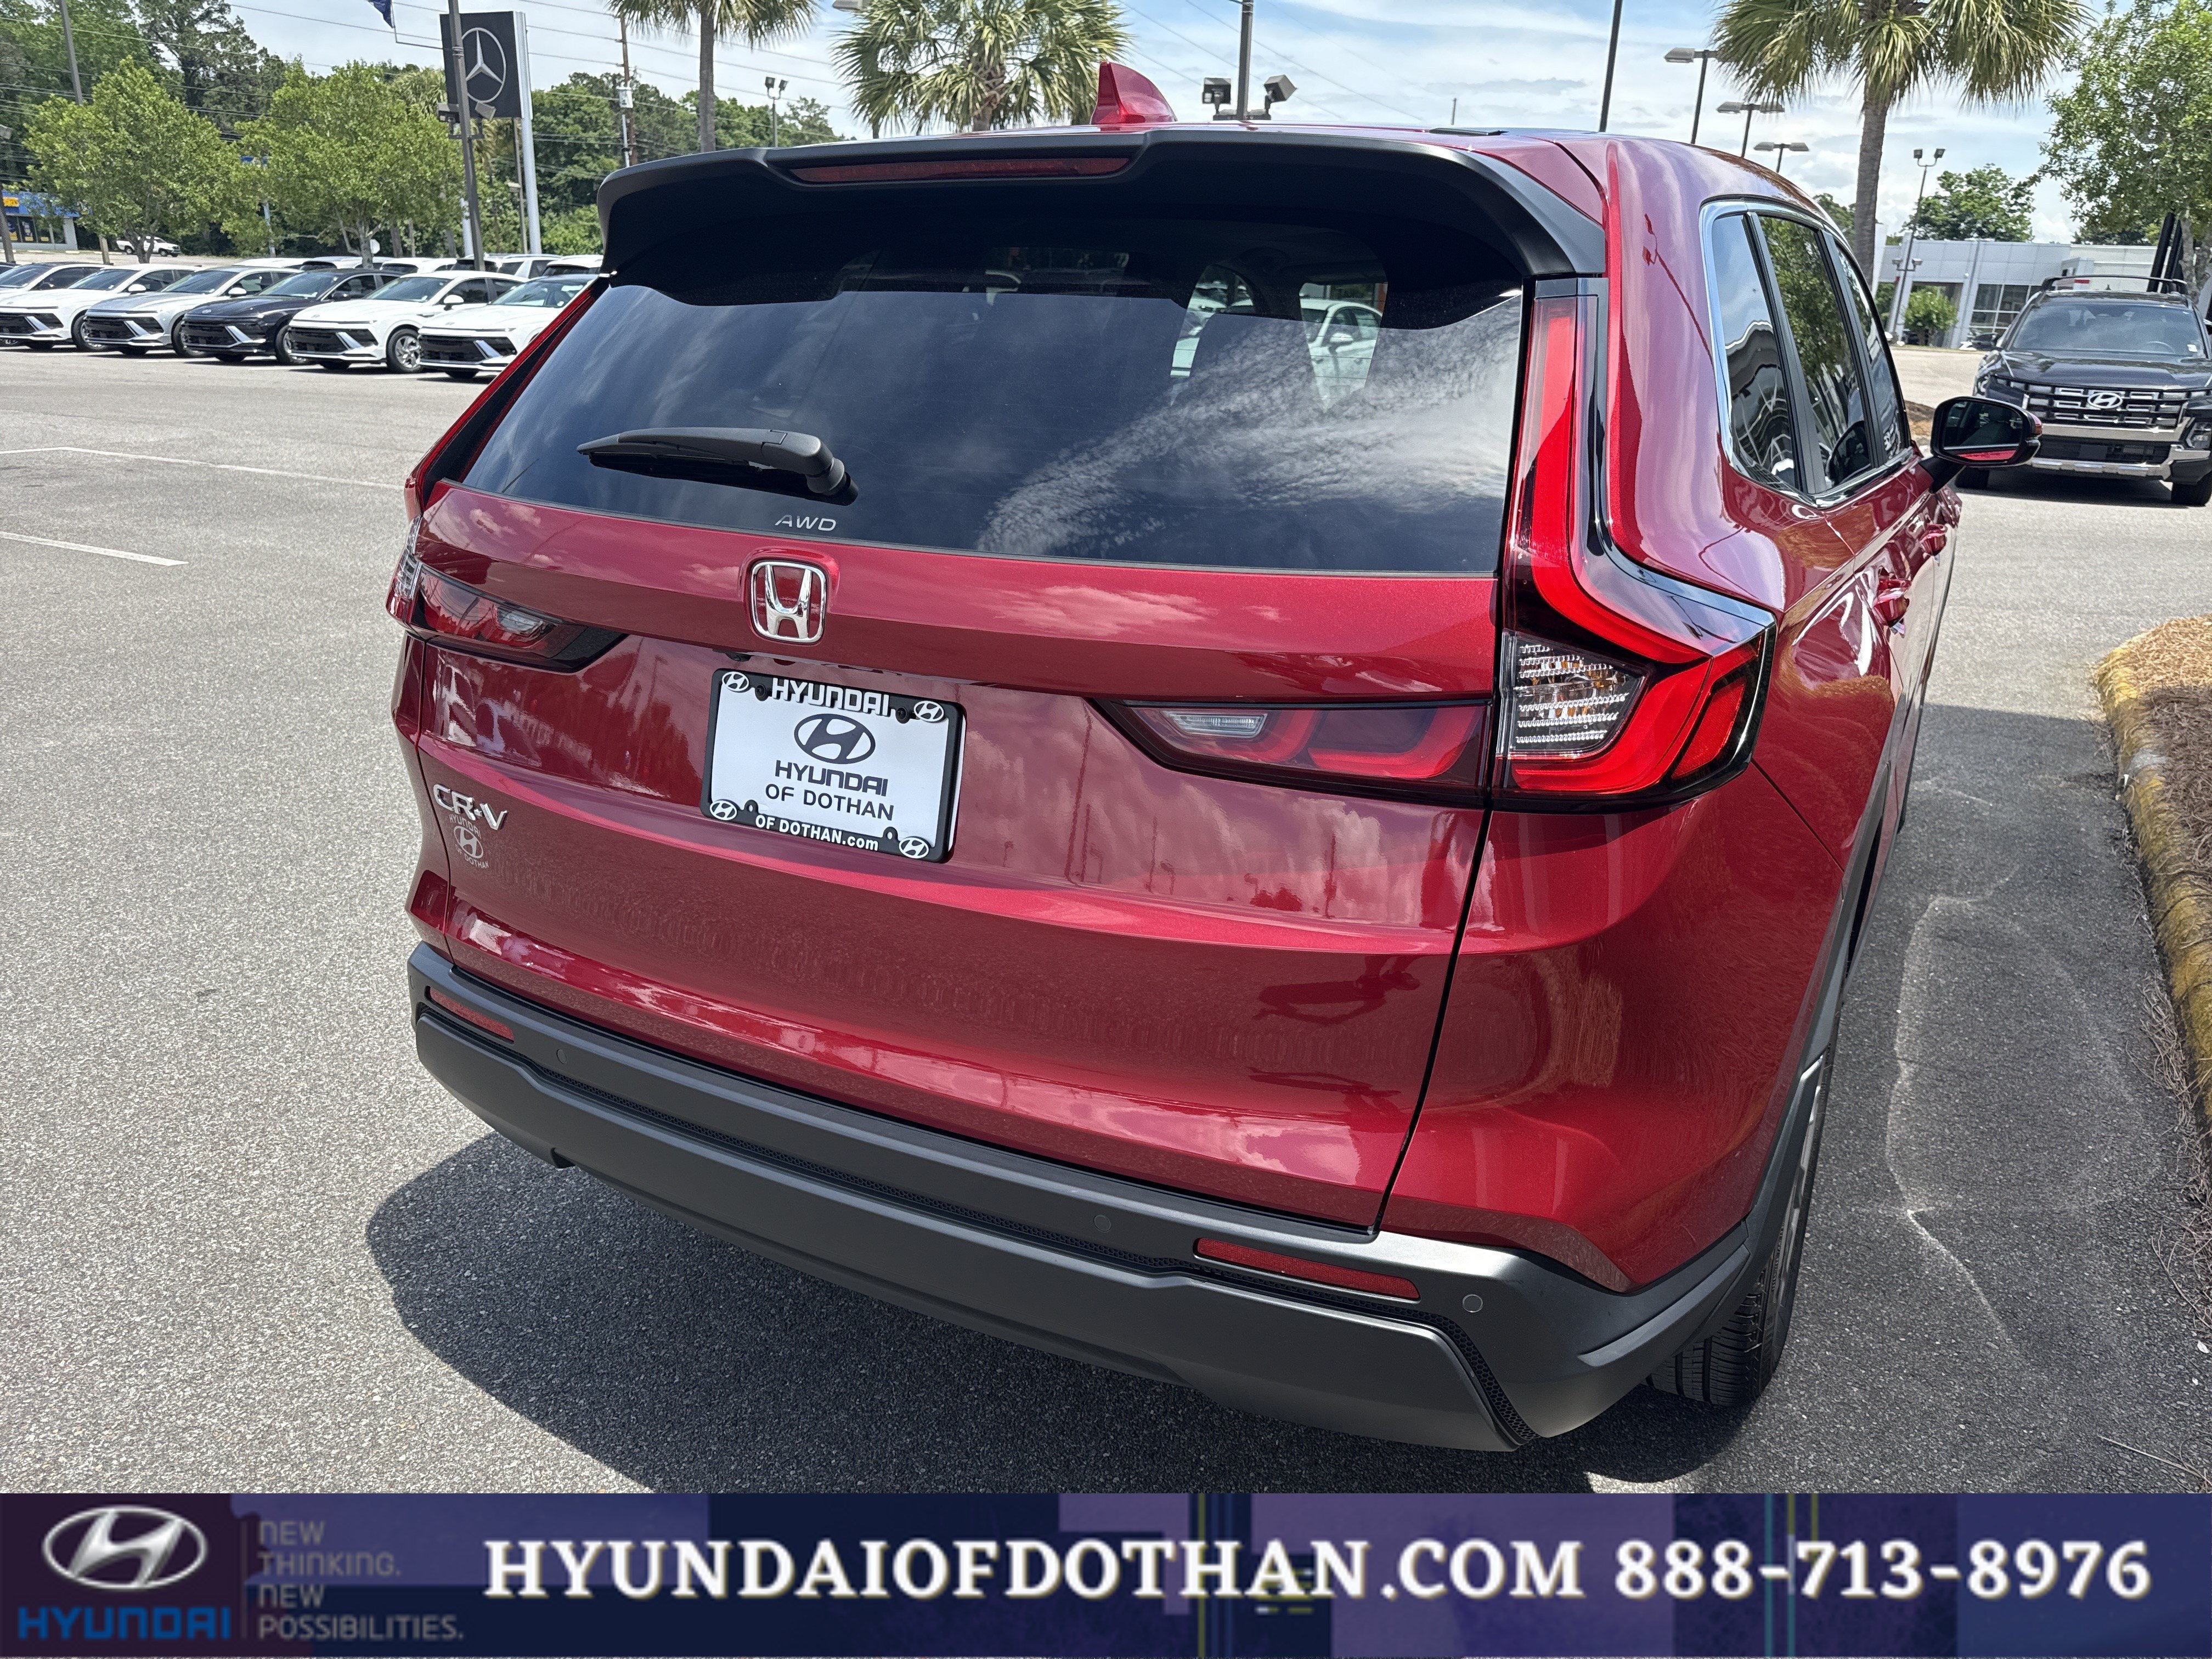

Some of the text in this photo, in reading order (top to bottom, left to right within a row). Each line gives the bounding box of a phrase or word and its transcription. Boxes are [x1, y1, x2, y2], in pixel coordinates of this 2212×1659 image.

[775, 515, 837, 531] AWD
[771, 678, 889, 716] HYUNDAI
[775, 760, 888, 797] HYUNDAI
[433, 784, 508, 831] CR-V
[765, 783, 894, 821] OF DOTHAN
[448, 814, 482, 840] HYUNDAI
[755, 815, 878, 851] OF DOTHAN.com
[464, 853, 489, 869] DOTHAN
